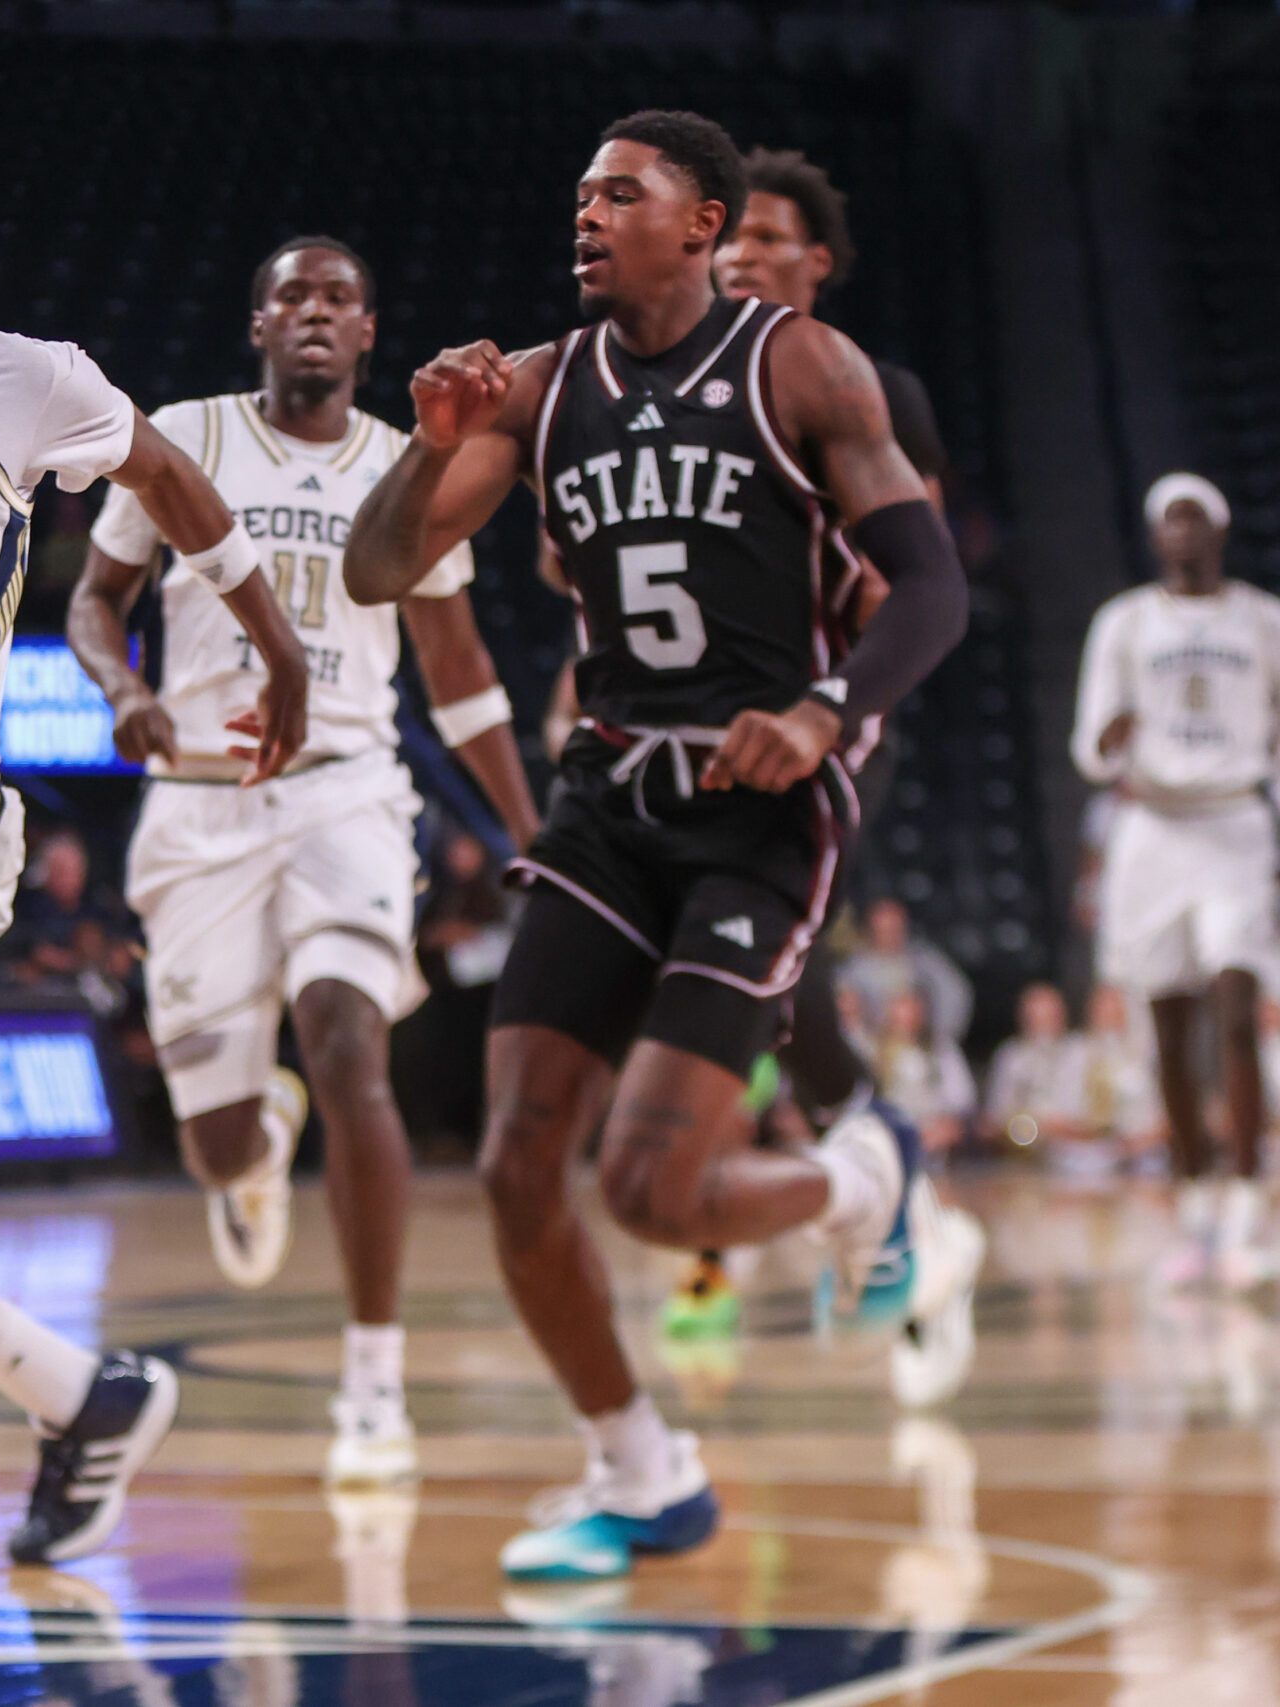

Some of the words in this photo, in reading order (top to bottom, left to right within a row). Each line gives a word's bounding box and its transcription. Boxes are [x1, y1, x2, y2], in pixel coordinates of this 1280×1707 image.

[233, 506, 352, 549] EORG
[552, 444, 756, 544] STATE
[273, 550, 330, 630] 11
[617, 540, 709, 671] 5
